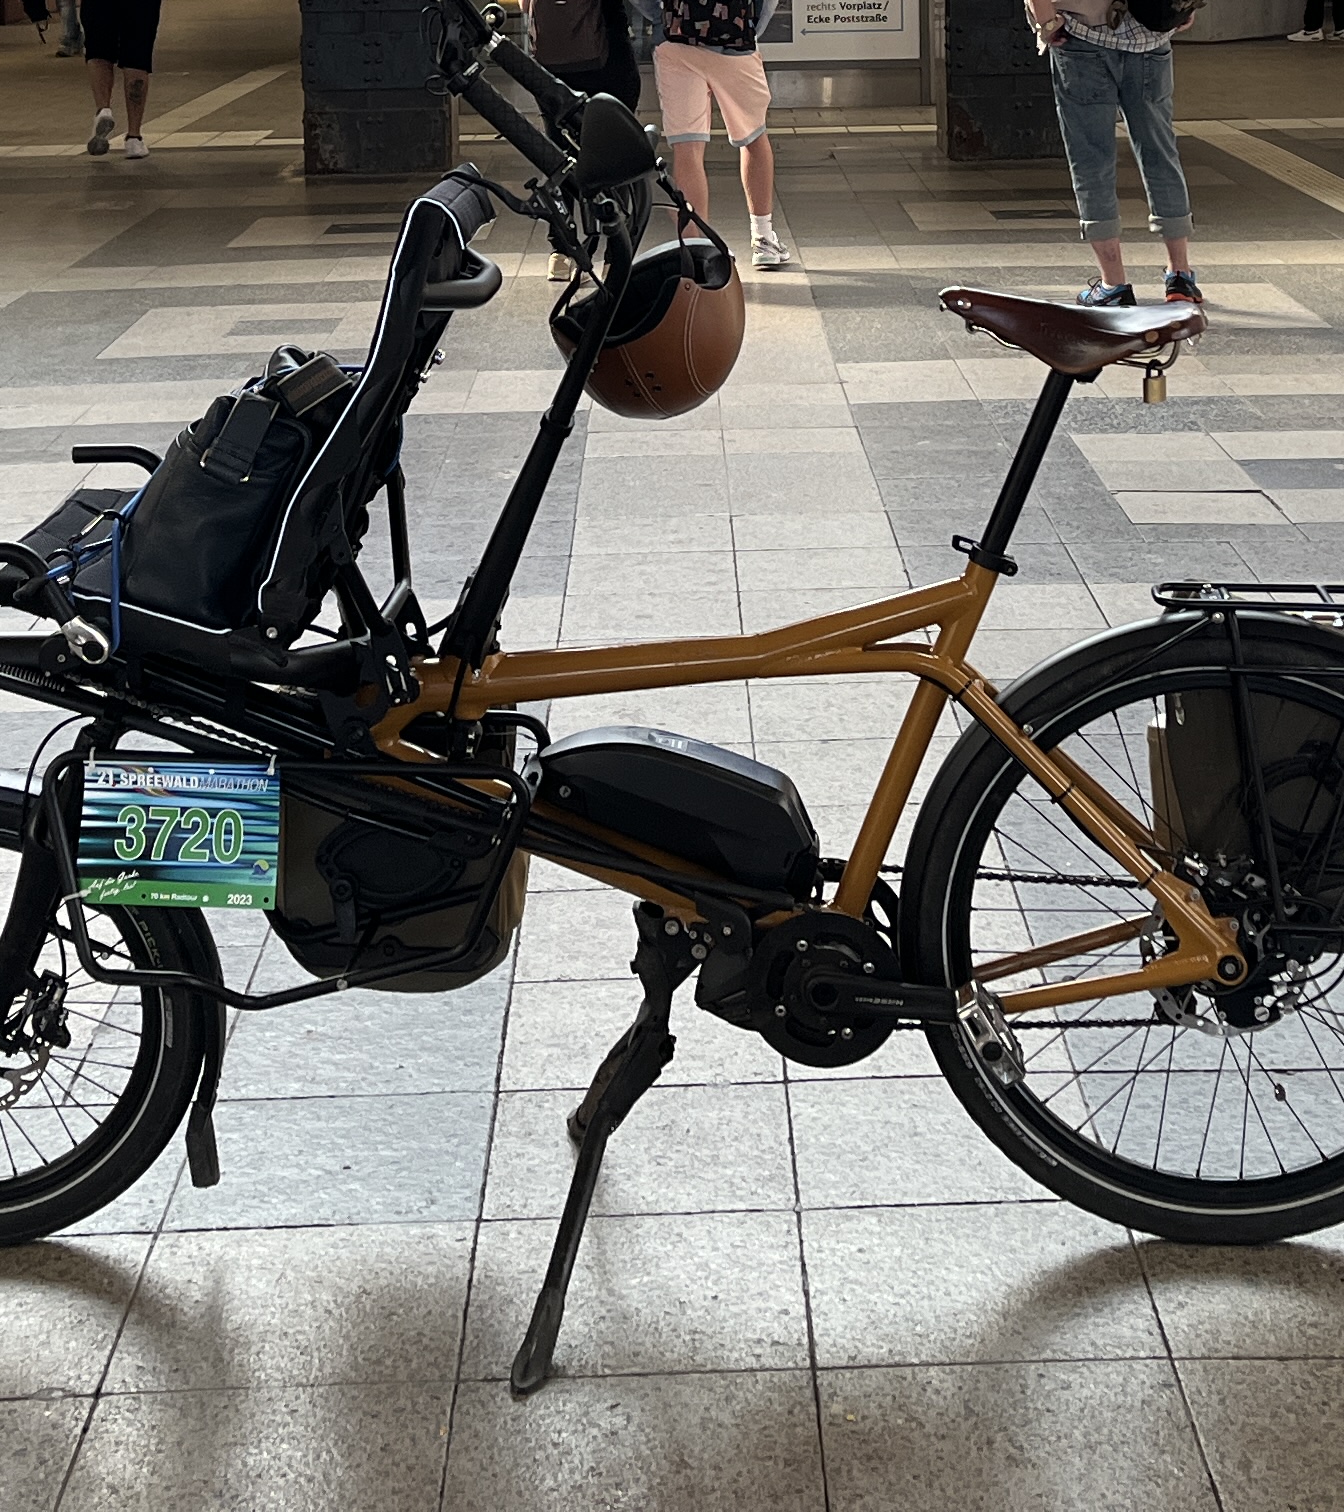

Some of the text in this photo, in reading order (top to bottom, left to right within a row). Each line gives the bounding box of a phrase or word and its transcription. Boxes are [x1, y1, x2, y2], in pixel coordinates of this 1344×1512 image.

[806, 2, 837, 12] rechts
[839, 0, 883, 12] Vorplatz
[806, 13, 888, 24] Ecke Poststraße
[114, 805, 244, 864] 3720
[227, 894, 253, 905] 2023
